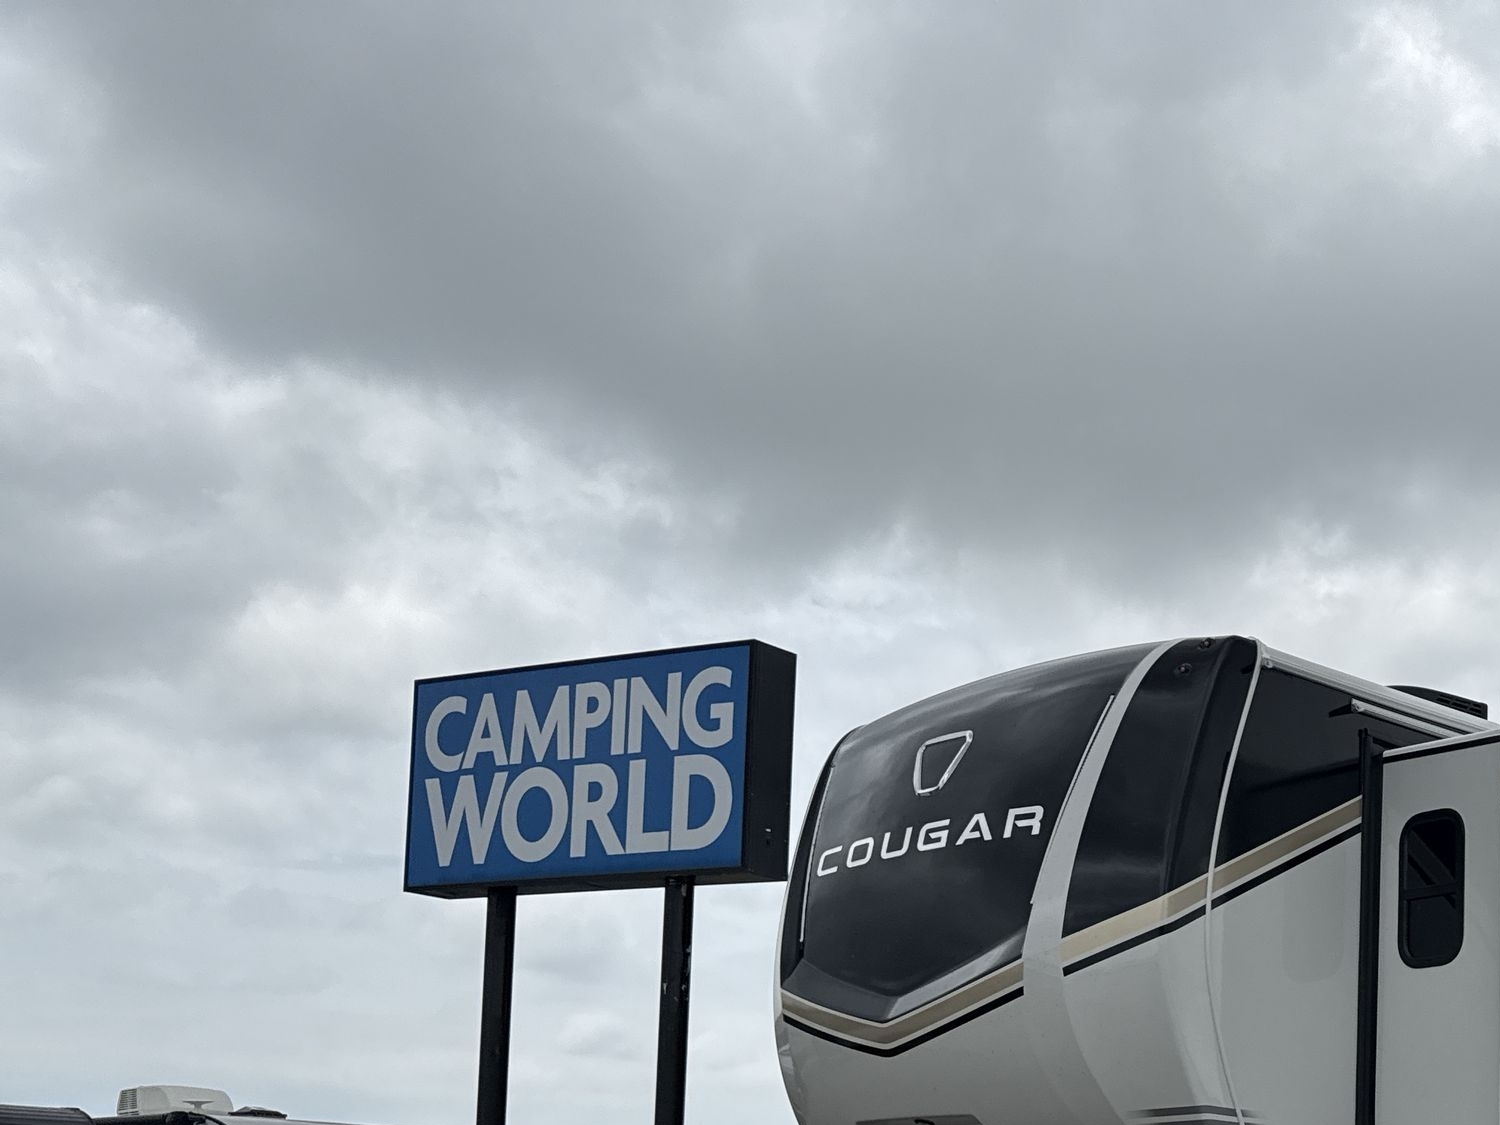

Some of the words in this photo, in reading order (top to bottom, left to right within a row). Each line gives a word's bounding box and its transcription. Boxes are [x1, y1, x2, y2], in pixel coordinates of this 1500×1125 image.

[425, 666, 735, 772] CAMPING
[425, 753, 734, 868] WORLD
[816, 805, 1044, 877] COUGAR
